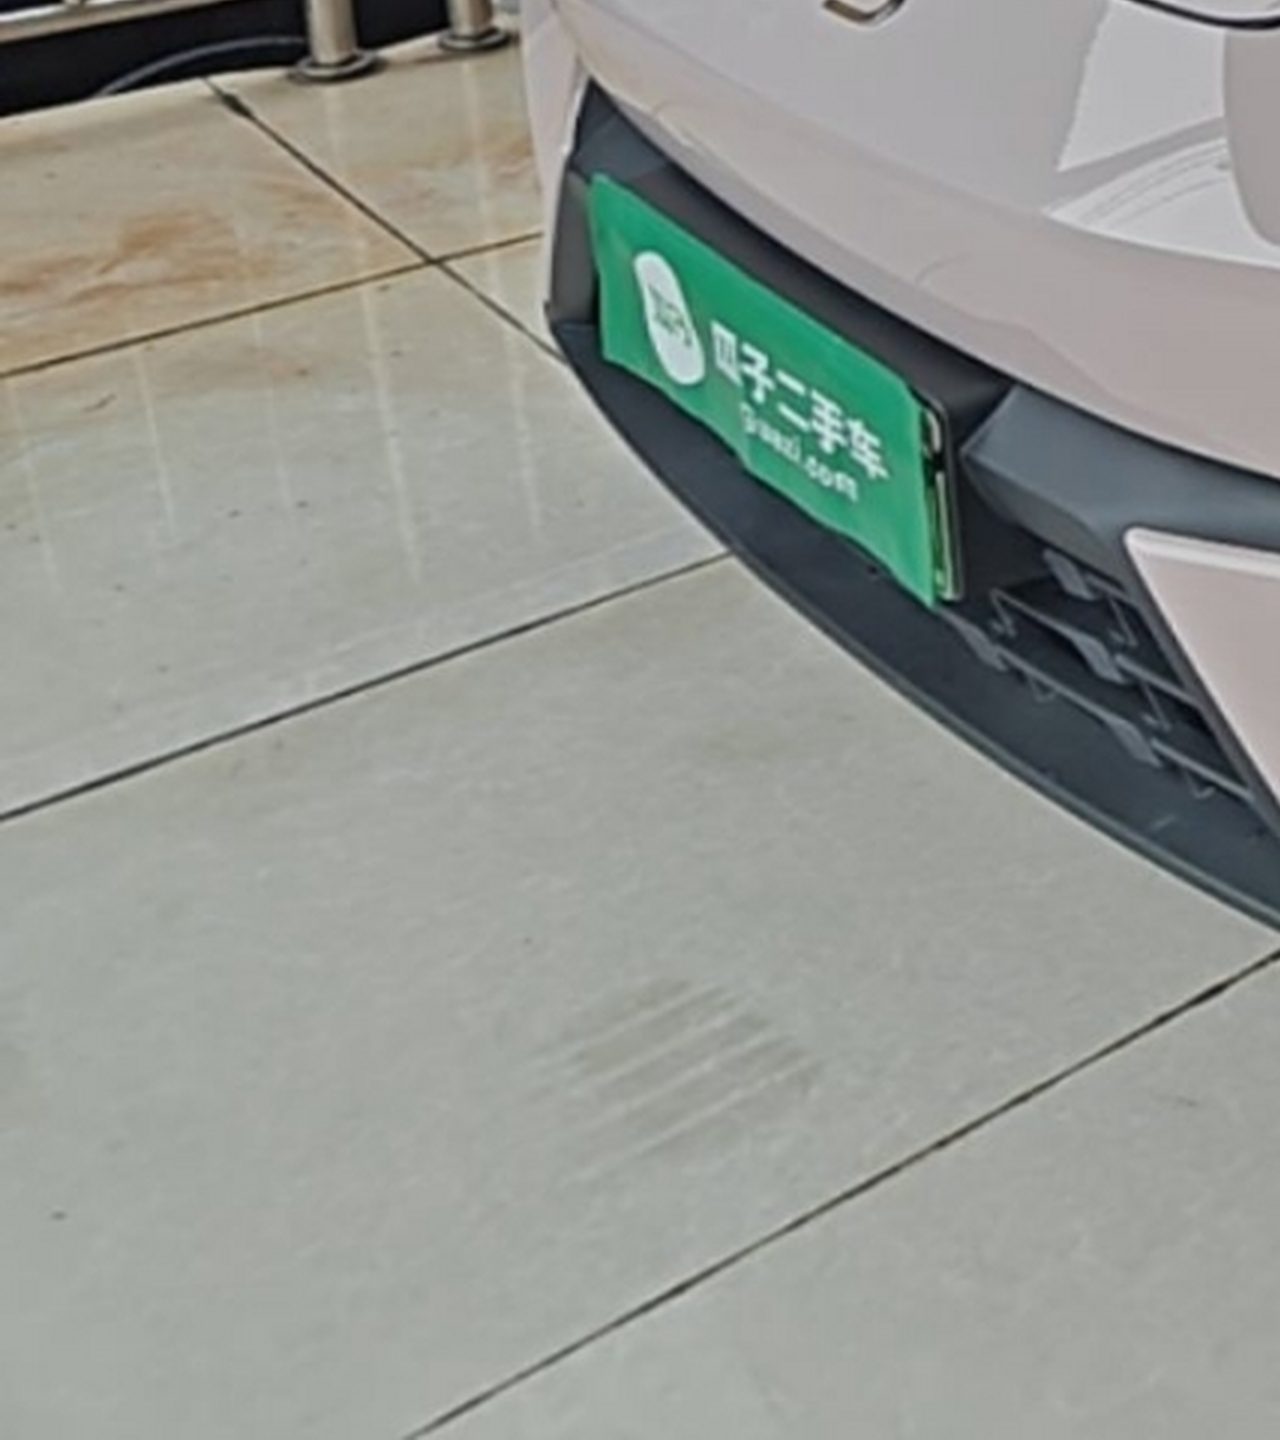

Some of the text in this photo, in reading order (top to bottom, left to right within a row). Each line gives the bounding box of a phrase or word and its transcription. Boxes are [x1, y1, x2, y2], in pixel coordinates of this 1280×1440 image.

[711, 319, 890, 479] 瓜子二手车
